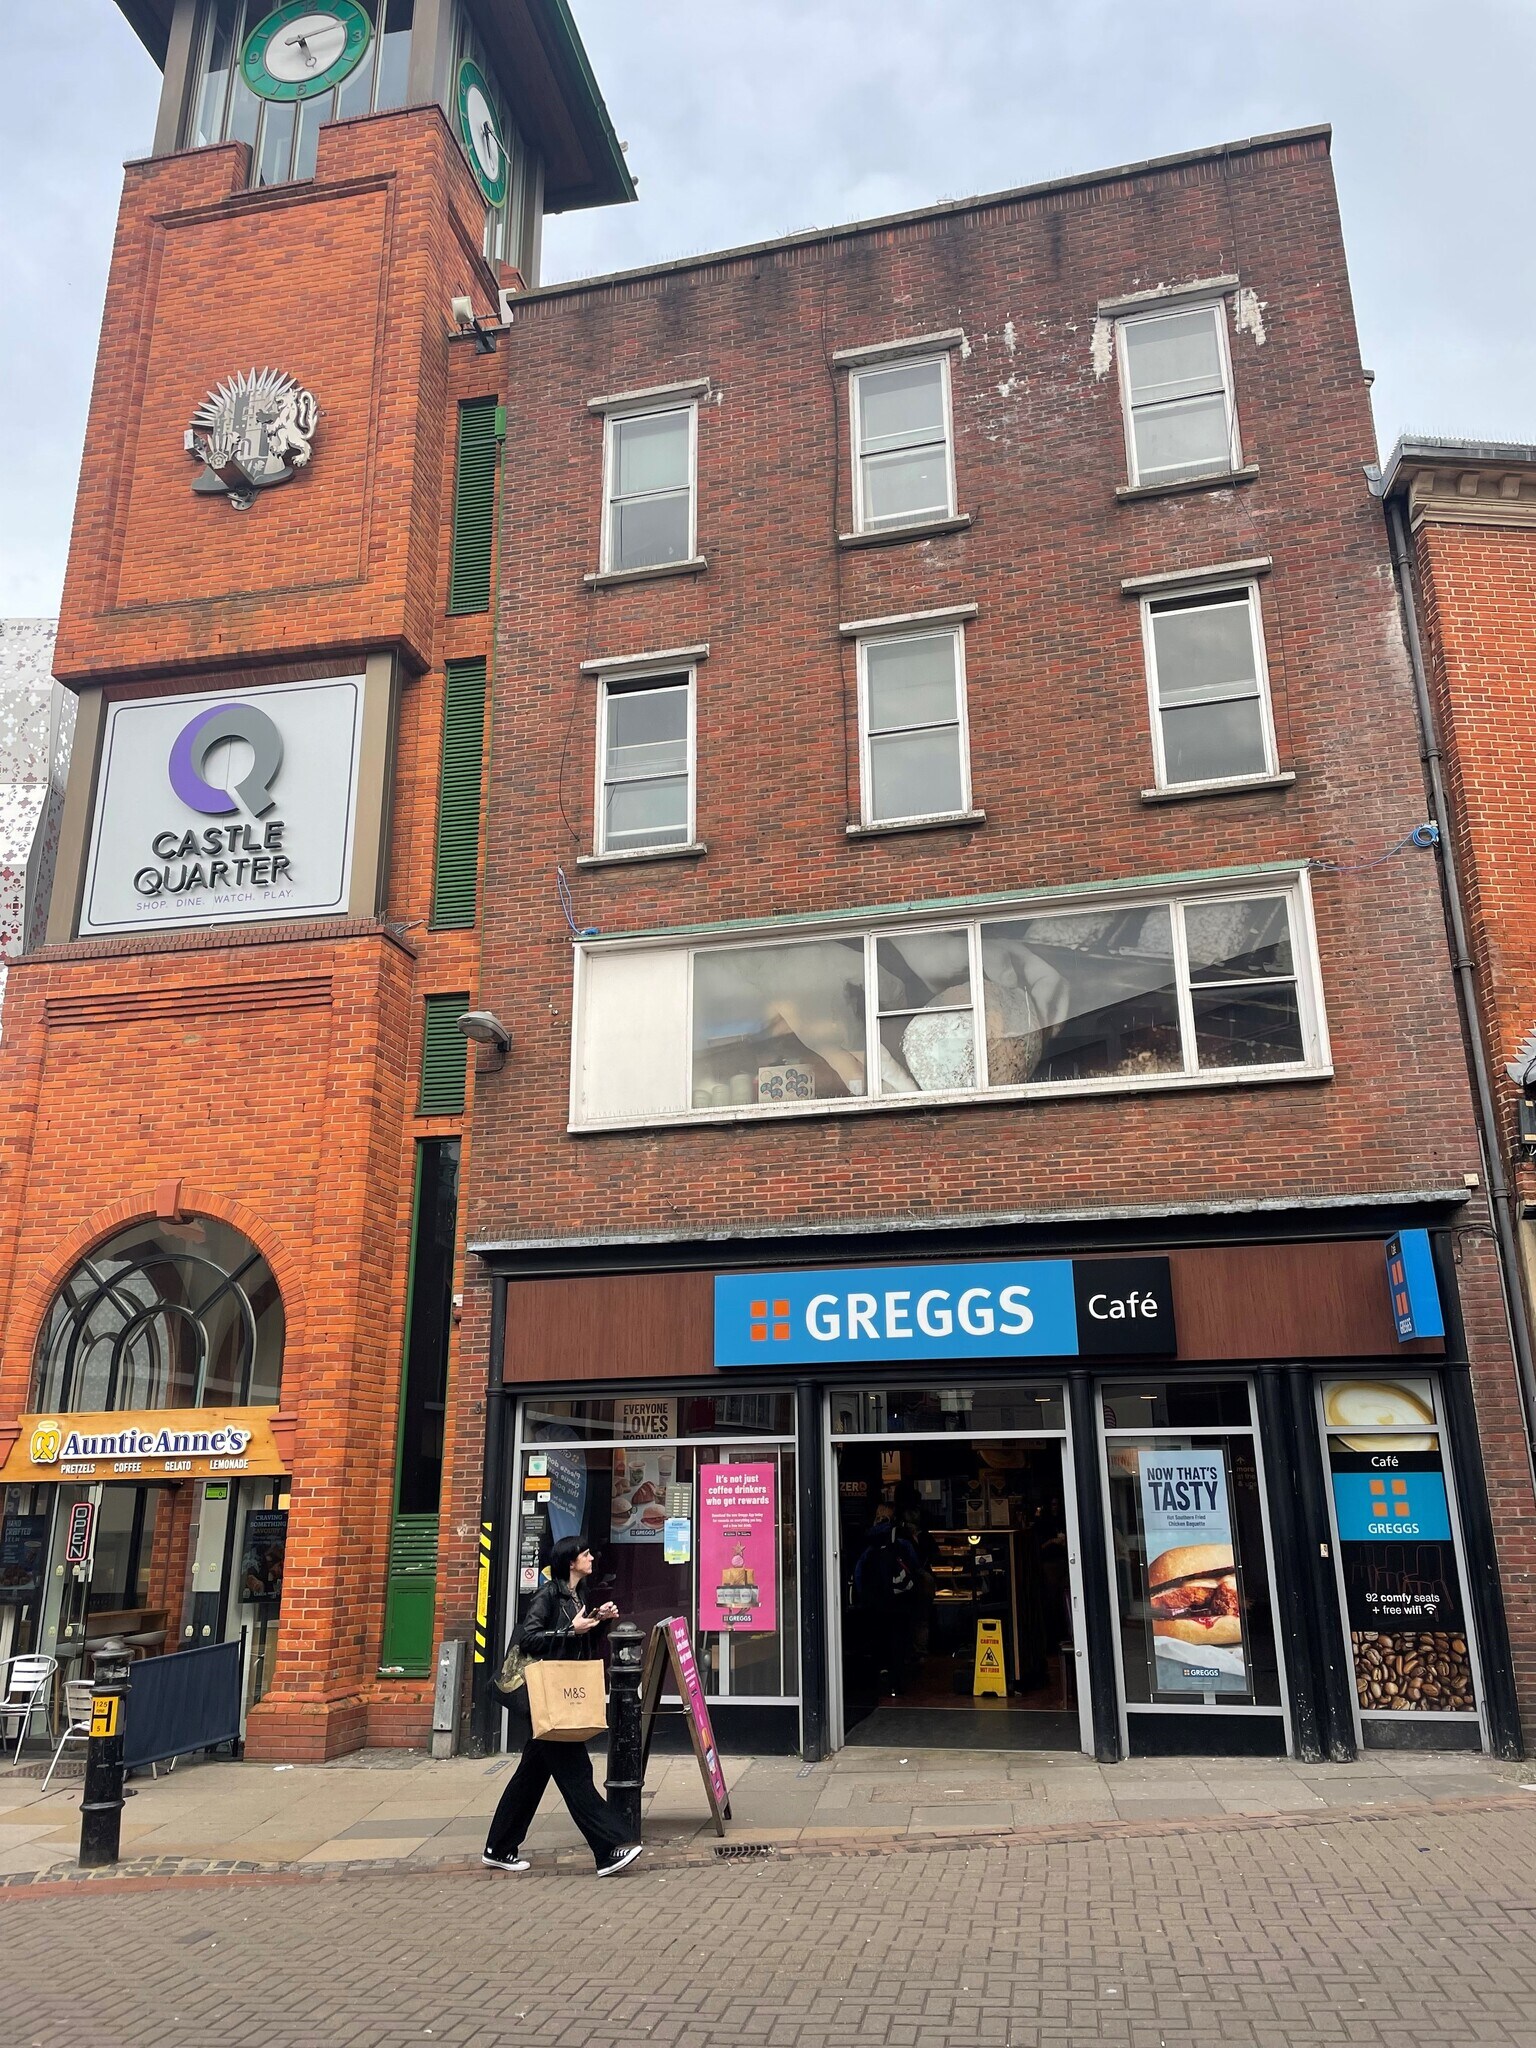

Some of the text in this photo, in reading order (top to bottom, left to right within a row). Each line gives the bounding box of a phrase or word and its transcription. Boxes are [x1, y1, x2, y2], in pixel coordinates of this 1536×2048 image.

[152, 820, 285, 860] CASTLE
[133, 855, 294, 896] QUARTER
[136, 889, 294, 911] SHOP. DINE. WATCH. PLAY.
[805, 1285, 1159, 1341] GREGGS Café
[623, 1403, 669, 1415] EVERYONE
[623, 1415, 669, 1434] LOVES
[60, 1459, 249, 1474] PRETZELS COFFEE GELATO LEMONADE
[1371, 1455, 1399, 1467] Café
[715, 1474, 759, 1485] It's not just
[1147, 1467, 1218, 1480] NOW THAT'S
[708, 1484, 767, 1495] coffee drinkers
[706, 1495, 769, 1507] who get rewards
[1148, 1481, 1218, 1511] TASTY
[69, 1507, 88, 1558] OPEN
[1368, 1523, 1420, 1534] GREGGS
[1365, 1593, 1440, 1603] 92 comfy seats
[1383, 1605, 1402, 1614] free
[1403, 1605, 1422, 1614] wifi
[563, 1687, 586, 1699] M&S
